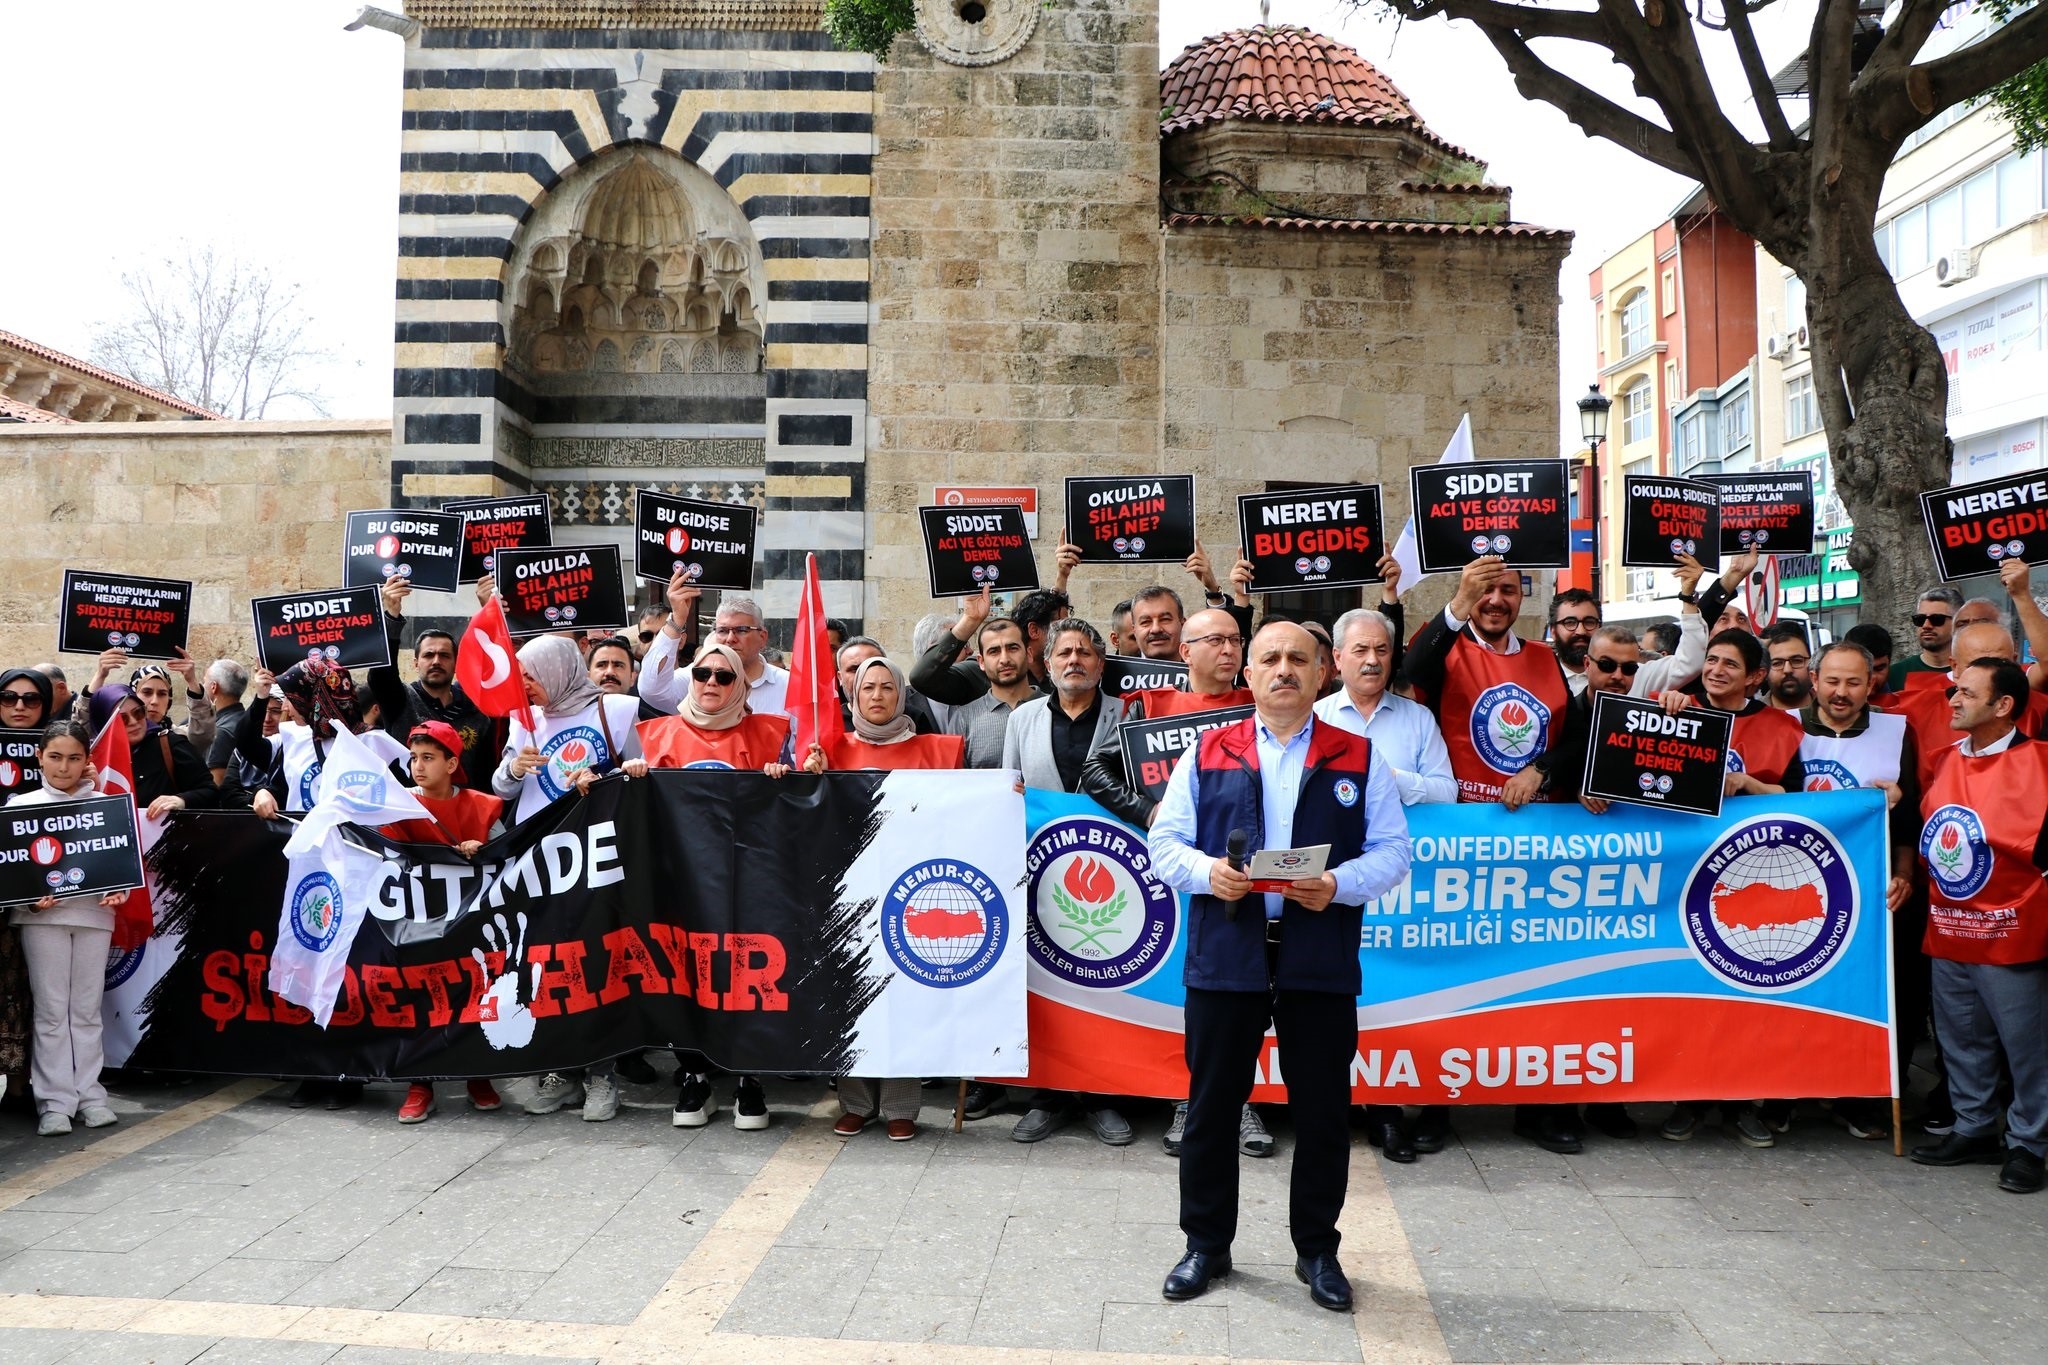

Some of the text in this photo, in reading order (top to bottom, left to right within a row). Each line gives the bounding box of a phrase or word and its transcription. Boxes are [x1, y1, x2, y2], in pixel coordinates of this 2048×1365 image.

[2012, 440, 2036, 454] BOSCH
[1088, 482, 1165, 508] OKULDA
[1631, 484, 1681, 500] OKULDA
[1734, 482, 1803, 493] KURUMLARINI
[1721, 492, 1784, 503] HEDEF ALAN
[1946, 480, 2048, 519] NEREYE
[656, 506, 676, 523] BU
[1262, 499, 1358, 526] NEREYE
[1430, 496, 1557, 518] ACI VE GÖZYAŞI
[1762, 504, 1801, 516] KARŞI
[367, 521, 387, 534] BU
[1124, 515, 1161, 535] NE?
[1462, 515, 1520, 532] DEMEK
[1658, 520, 1704, 539] BÜYÜK
[1721, 516, 1788, 529] AYAKTAYIZ
[1943, 508, 2048, 548] BU GİDİ
[641, 529, 665, 545] DUR
[938, 534, 1023, 550] ACI VE GÖZYAŞI
[1254, 531, 1293, 557] BU
[351, 544, 375, 557] DUR
[963, 549, 1002, 562] DEMEK
[515, 552, 591, 579] OKULDA
[95, 594, 160, 608] HEDEF ALAN
[111, 585, 182, 601] KURUMLARINI
[554, 585, 590, 604] NE?
[135, 609, 175, 624] KARŞI
[88, 618, 160, 634] AYAKTAYIZ
[269, 614, 373, 638] ACI VE GÖZYAŞI
[298, 630, 345, 646] DEMEK
[1606, 732, 1717, 763] ACI VE GÖZYAŞI
[1634, 752, 1684, 773] DEMEK
[1642, 791, 1665, 800] ADANA
[12, 818, 39, 836] BU
[1707, 826, 1784, 874] MEMUR
[55, 885, 80, 893] ADANA
[893, 864, 996, 903] MEMUR-SEN
[1402, 913, 1502, 948] BİRLİĞİ
[1510, 910, 1656, 943] SENDİKASI
[1938, 927, 1955, 937] GENEL
[888, 915, 1001, 982] MEMUR SENDİKALARI KONFEDERASYONU
[1080, 948, 1101, 958] 1992
[1690, 910, 1848, 984] MEMUR SENDİKALARI KONFEDERASYONU
[527, 922, 789, 1018] HAYIR
[1439, 1027, 1634, 1099] ŞUBESİ
